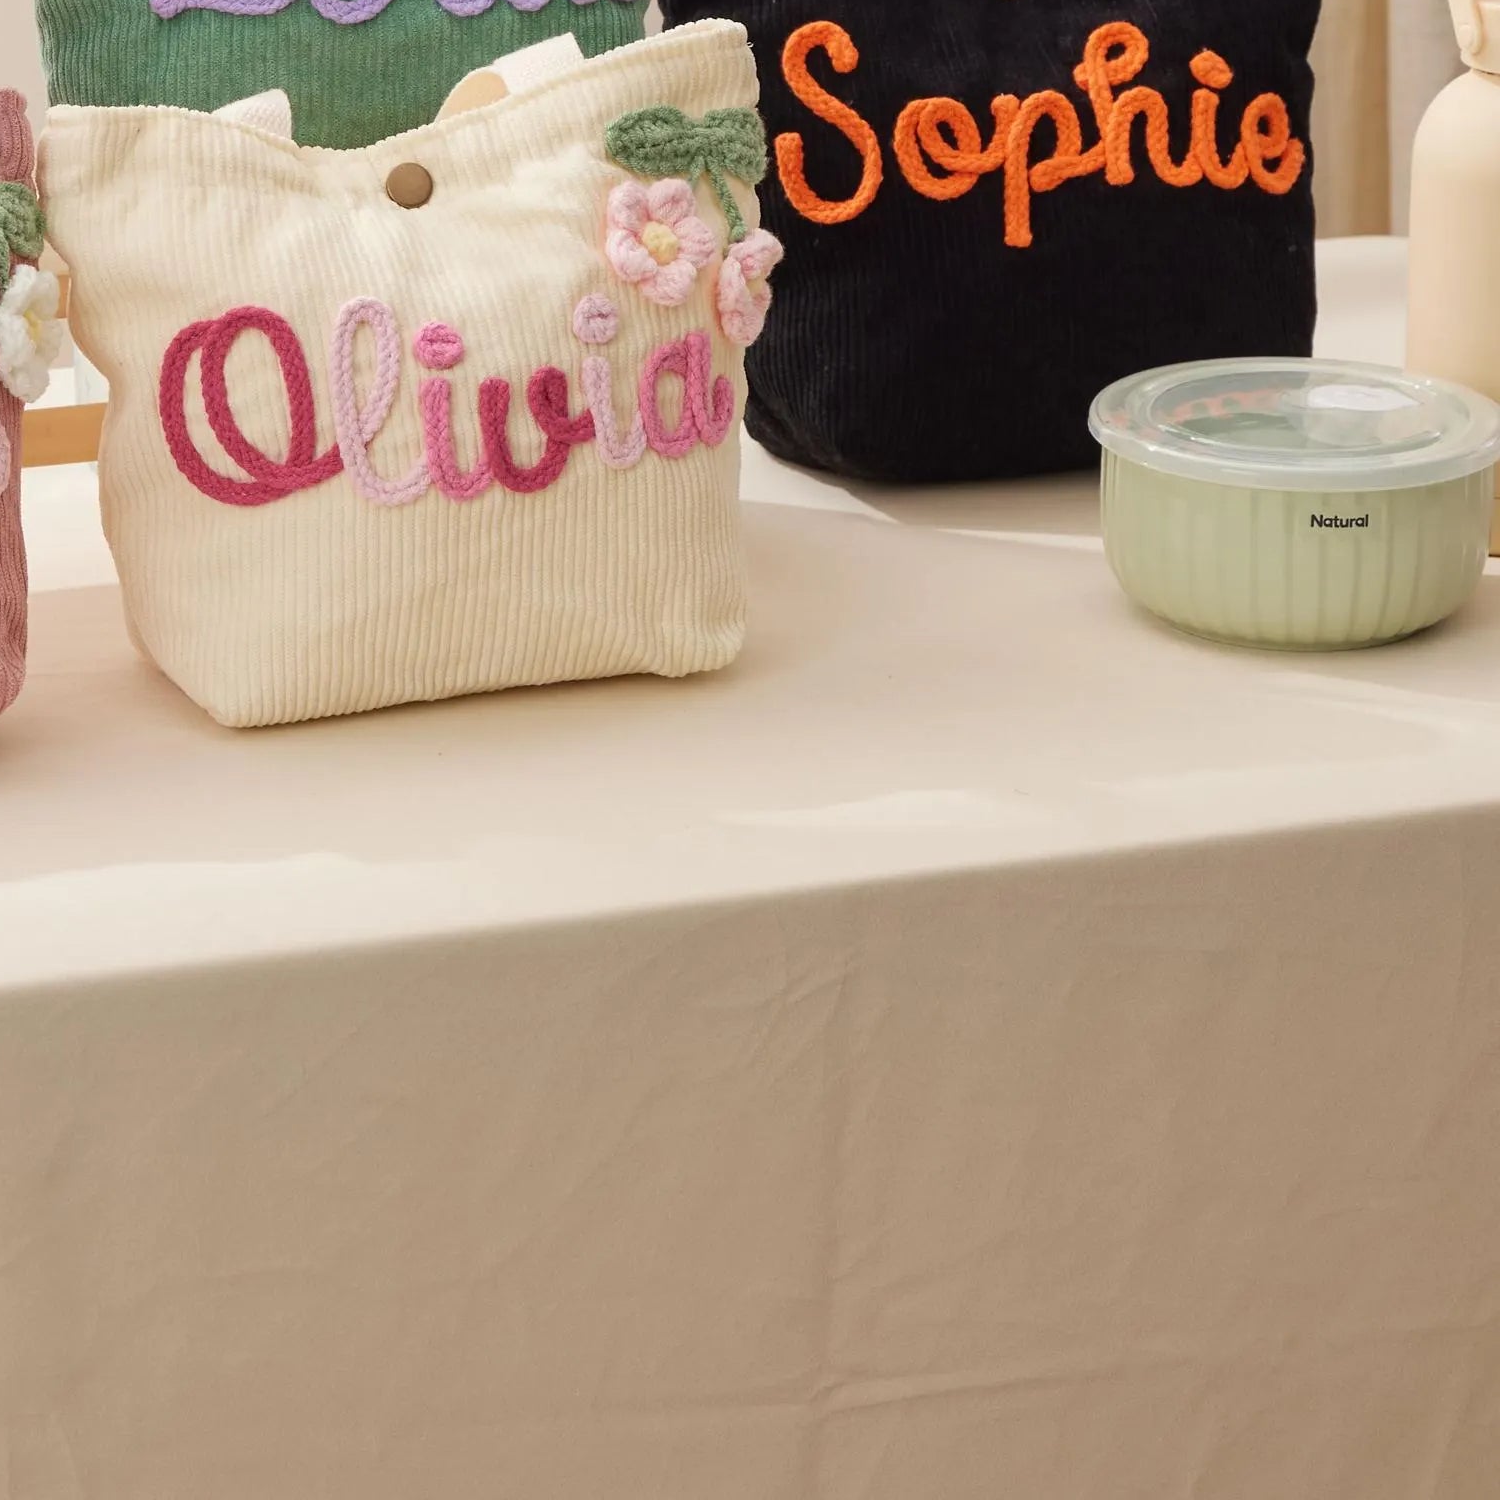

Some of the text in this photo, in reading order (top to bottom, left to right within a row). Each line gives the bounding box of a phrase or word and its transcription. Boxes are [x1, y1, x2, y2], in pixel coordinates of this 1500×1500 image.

[775, 20, 1304, 248] Sophie
[159, 295, 734, 507] Olivia
[1310, 513, 1369, 528] Natural
